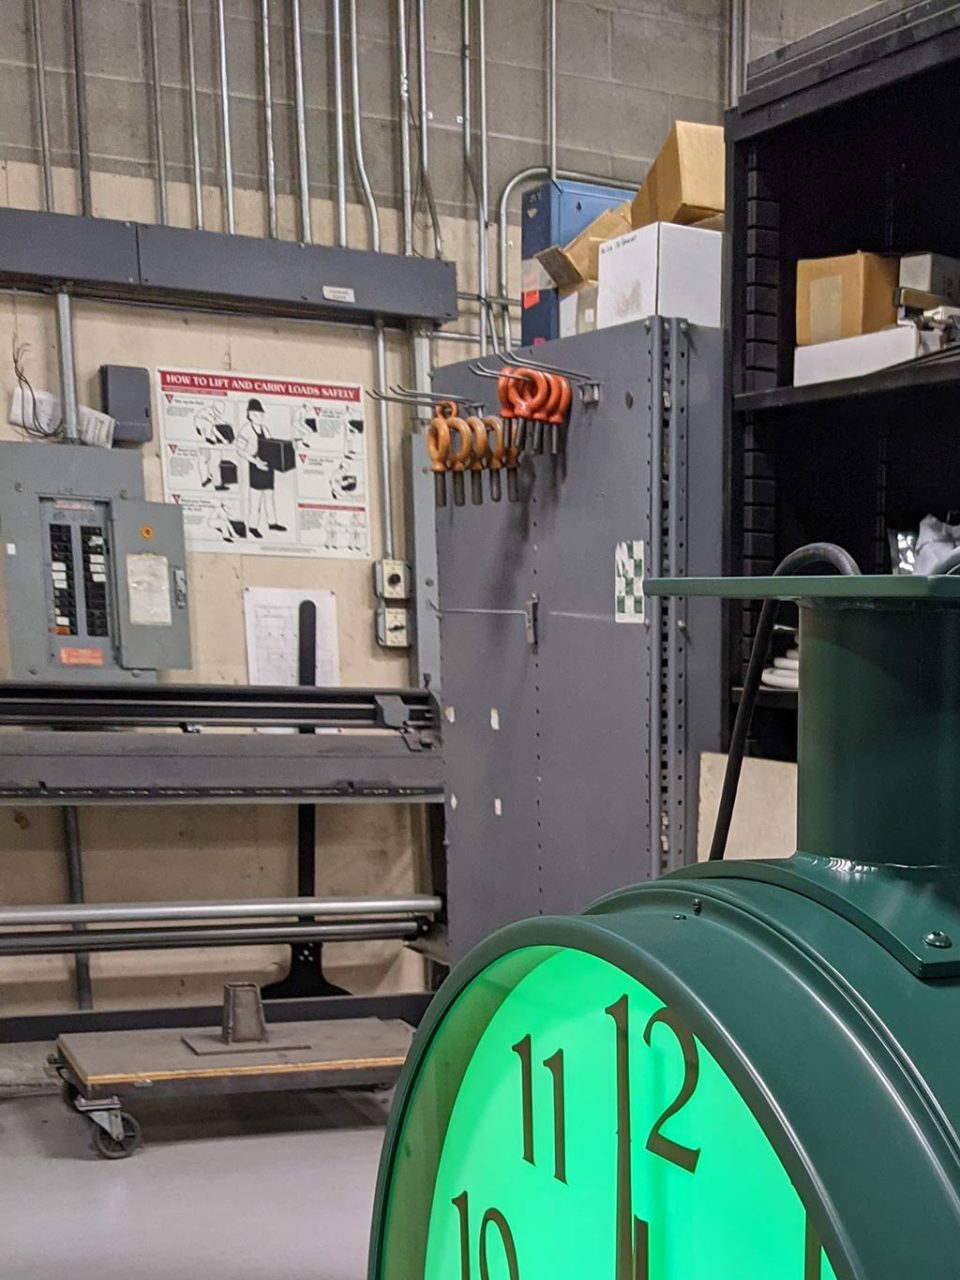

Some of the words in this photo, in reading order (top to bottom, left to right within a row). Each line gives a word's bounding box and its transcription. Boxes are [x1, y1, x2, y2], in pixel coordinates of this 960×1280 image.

[166, 373, 191, 385] HOW
[192, 375, 207, 386] TO
[208, 377, 229, 388] LIFT
[231, 379, 253, 390] AND
[254, 381, 287, 393] CARRY
[287, 384, 320, 395] LOADS
[321, 388, 354, 399] SAFELY
[511, 1034, 568, 1185] 11
[605, 993, 700, 1174] 12
